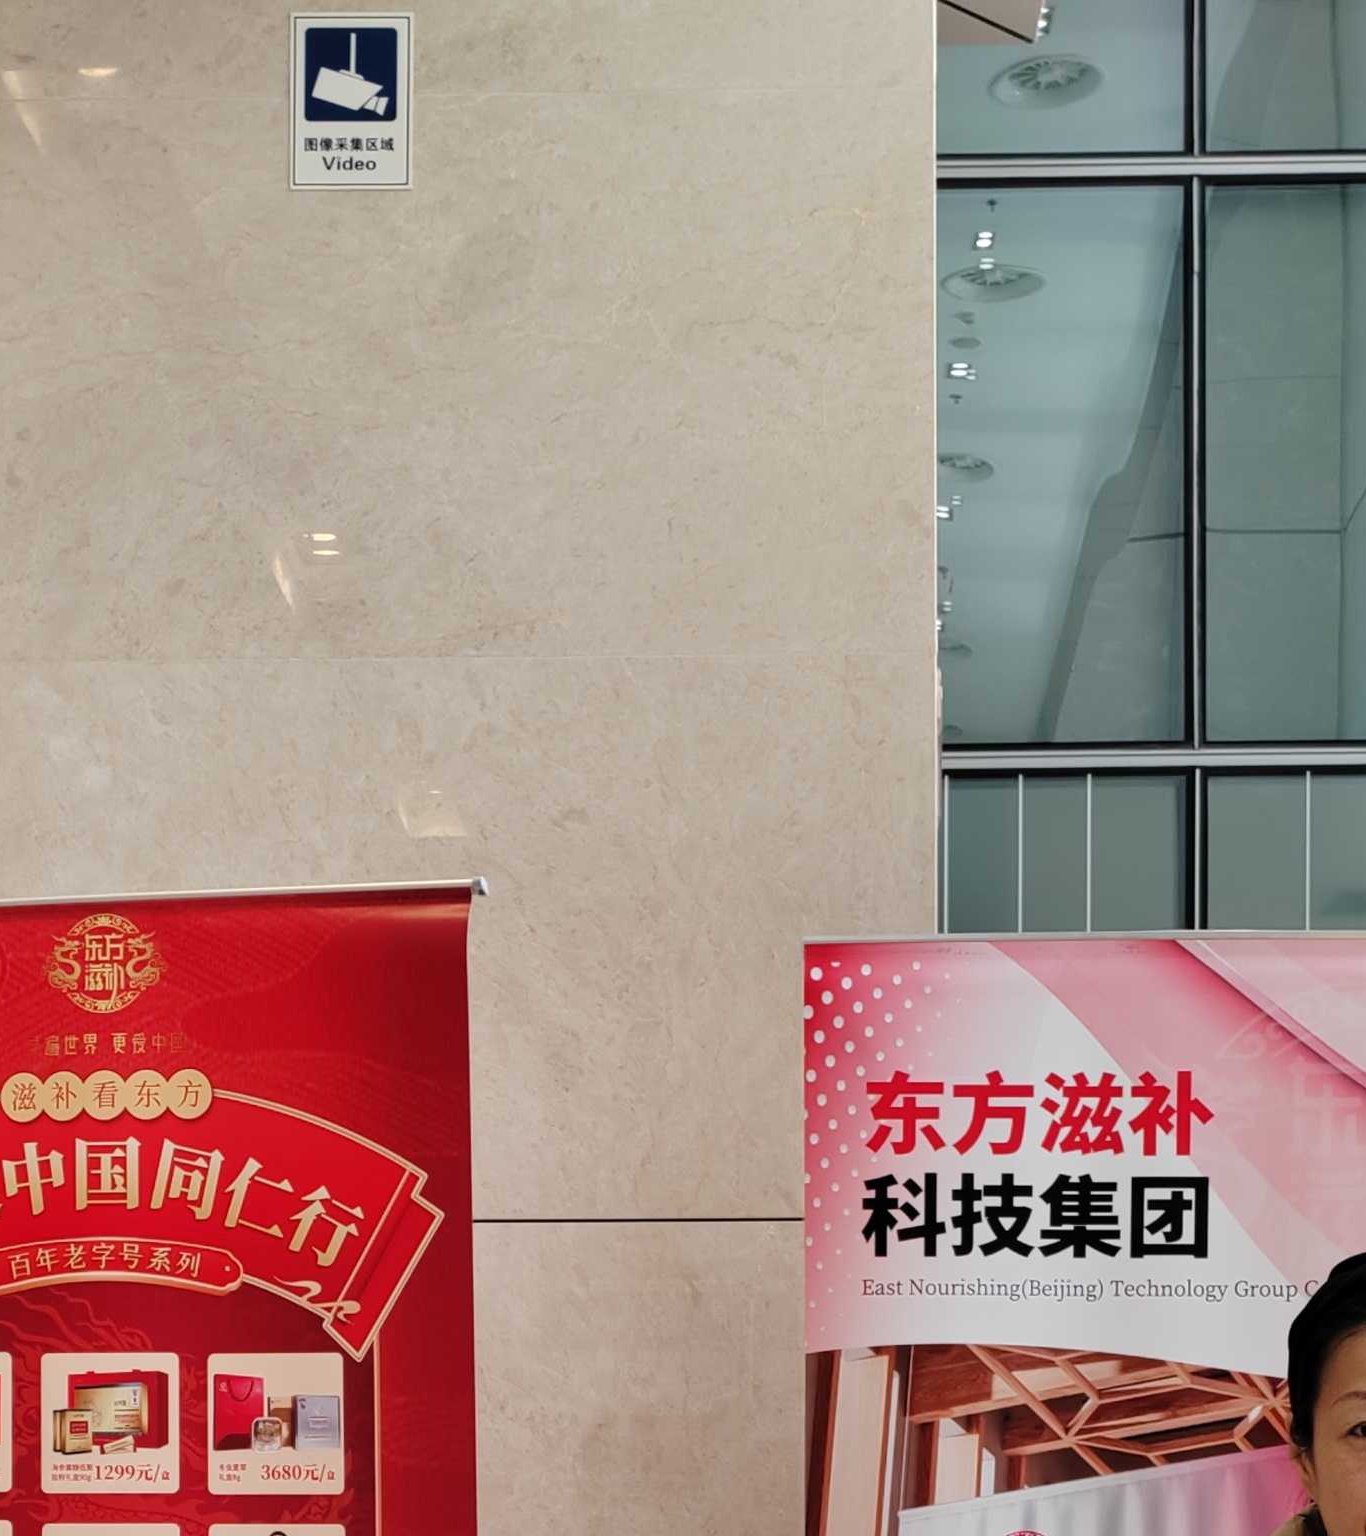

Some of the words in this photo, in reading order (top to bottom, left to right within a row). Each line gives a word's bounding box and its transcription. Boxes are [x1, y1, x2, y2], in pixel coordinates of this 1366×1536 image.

[304, 137, 395, 152] 图像采集区域
[322, 156, 377, 171] Video
[11, 1080, 205, 1112] 滋补看东方
[865, 1070, 1215, 1156] 东方滋补
[861, 1172, 1210, 1259] 科技集团
[8, 1243, 202, 1280] 百年老字号系列
[861, 1279, 904, 1298] East
[908, 1279, 1105, 1302] Nourishing(Beijing)
[1110, 1279, 1229, 1302] Technology
[1233, 1279, 1298, 1302] Group
